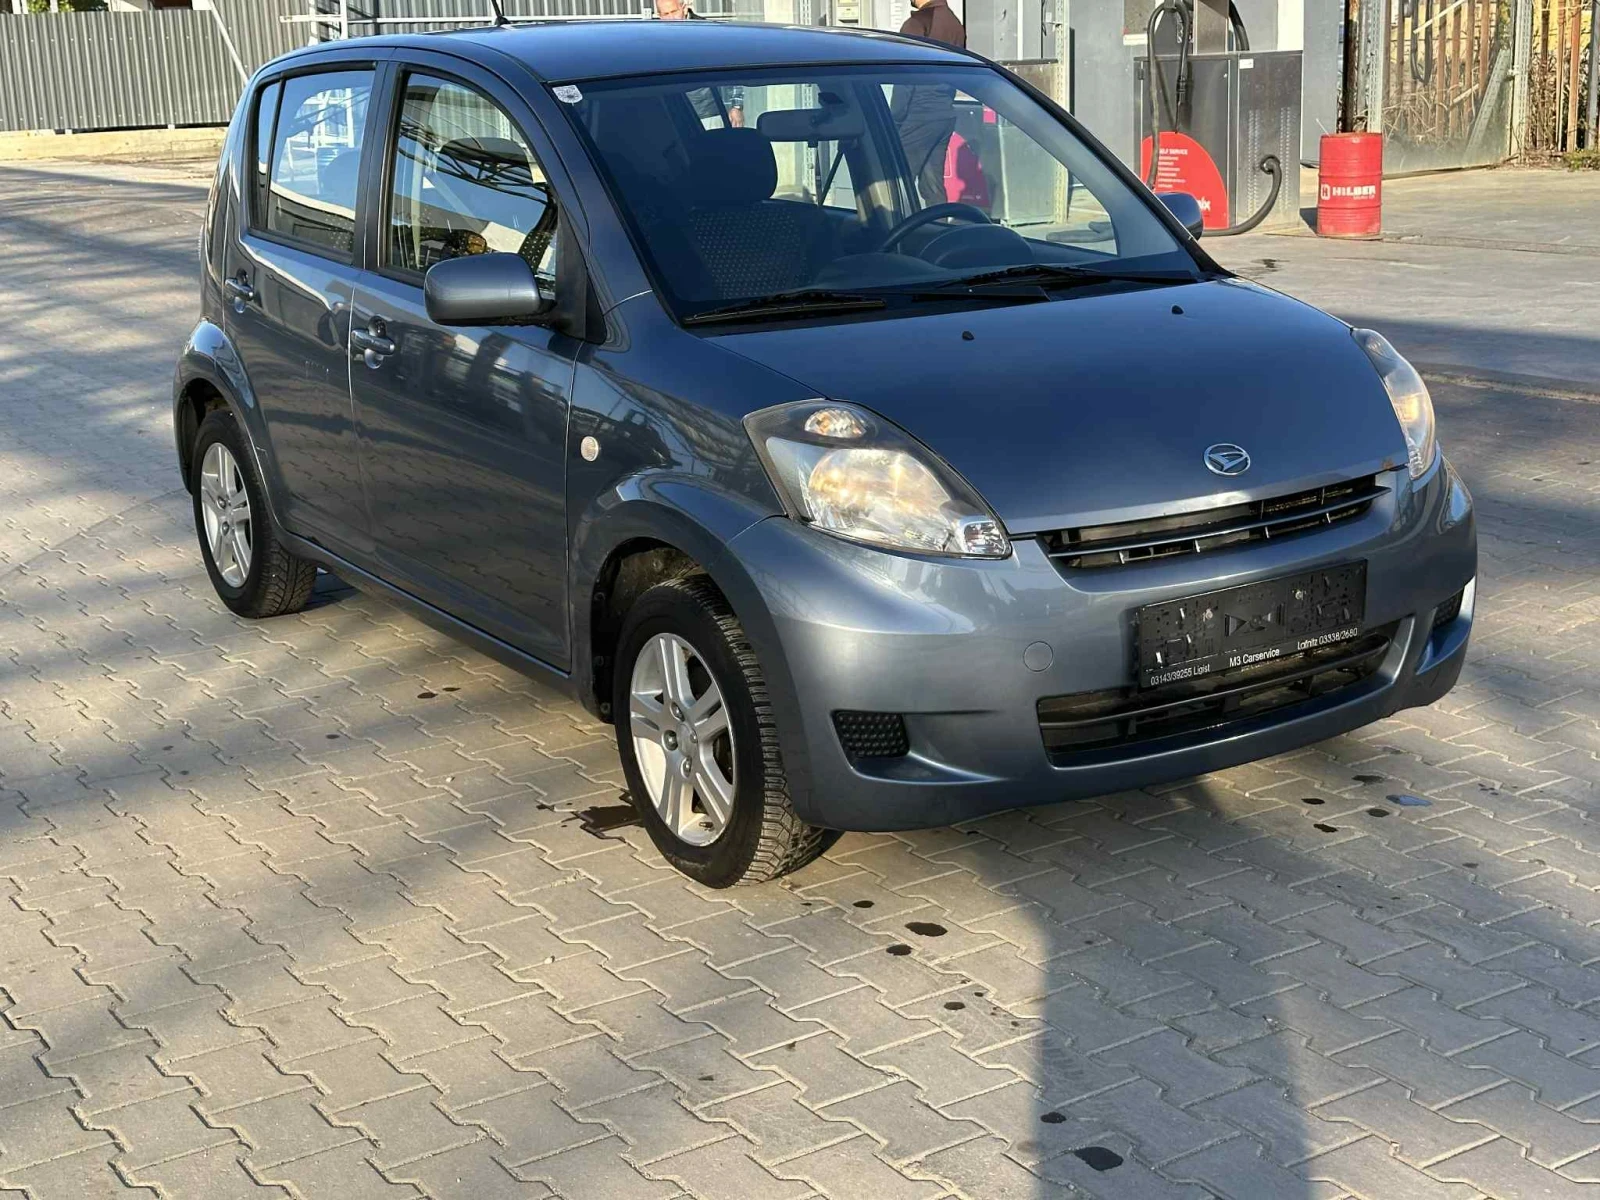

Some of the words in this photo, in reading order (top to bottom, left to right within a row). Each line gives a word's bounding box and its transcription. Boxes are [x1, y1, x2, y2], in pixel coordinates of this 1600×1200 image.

[1332, 185, 1376, 197] HILBER
[1230, 656, 1241, 667] M3
[1242, 648, 1280, 664] Carservice
[1150, 667, 1193, 686] 03143/39255
[1193, 663, 1211, 675] Ligist
